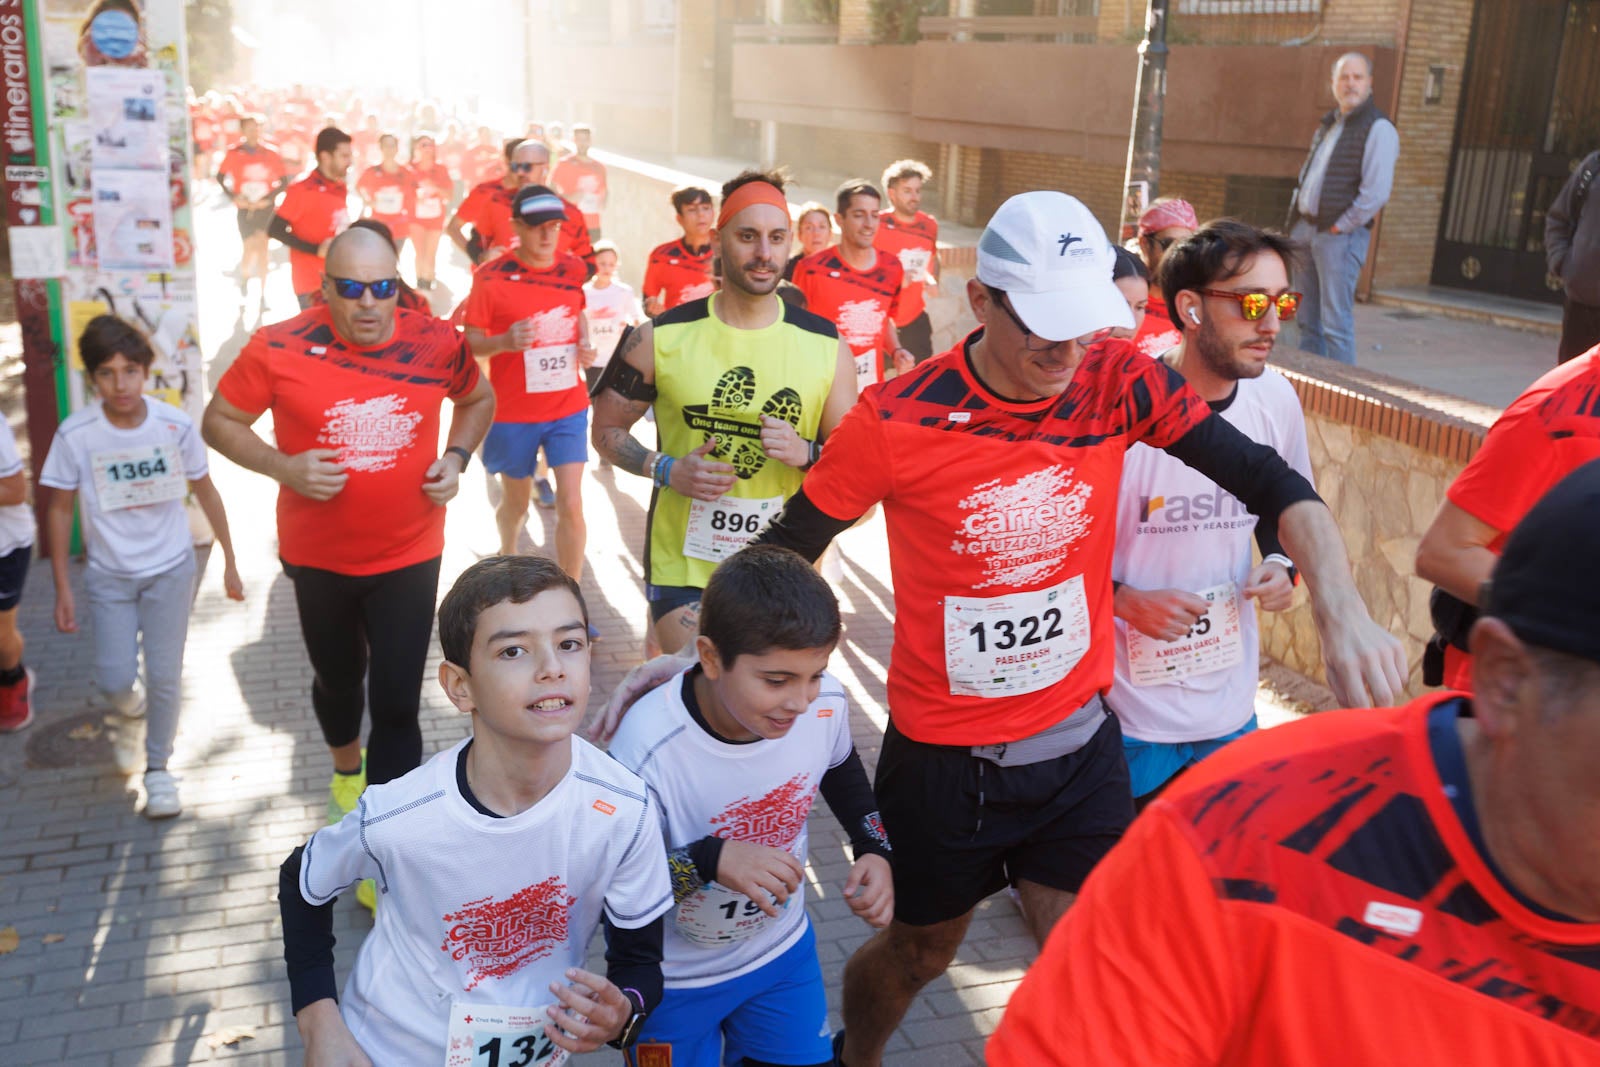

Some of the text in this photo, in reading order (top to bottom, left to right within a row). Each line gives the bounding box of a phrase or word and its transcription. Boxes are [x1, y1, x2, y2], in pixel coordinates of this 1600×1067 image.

[0, 14, 33, 152] tinerarios
[539, 355, 567, 371] 925
[327, 415, 413, 433] carrera
[692, 417, 712, 428] One
[714, 421, 739, 432] team
[107, 457, 167, 481] 1364
[965, 495, 1082, 535] carrera
[1139, 485, 1248, 523] rash
[711, 510, 760, 533] 896
[1136, 525, 1189, 535] SEGUROS
[967, 522, 1084, 554] cruzroja.es
[1008, 554, 1036, 567] NOV
[969, 607, 1064, 652] 1322
[995, 647, 1051, 666] PABLERASH
